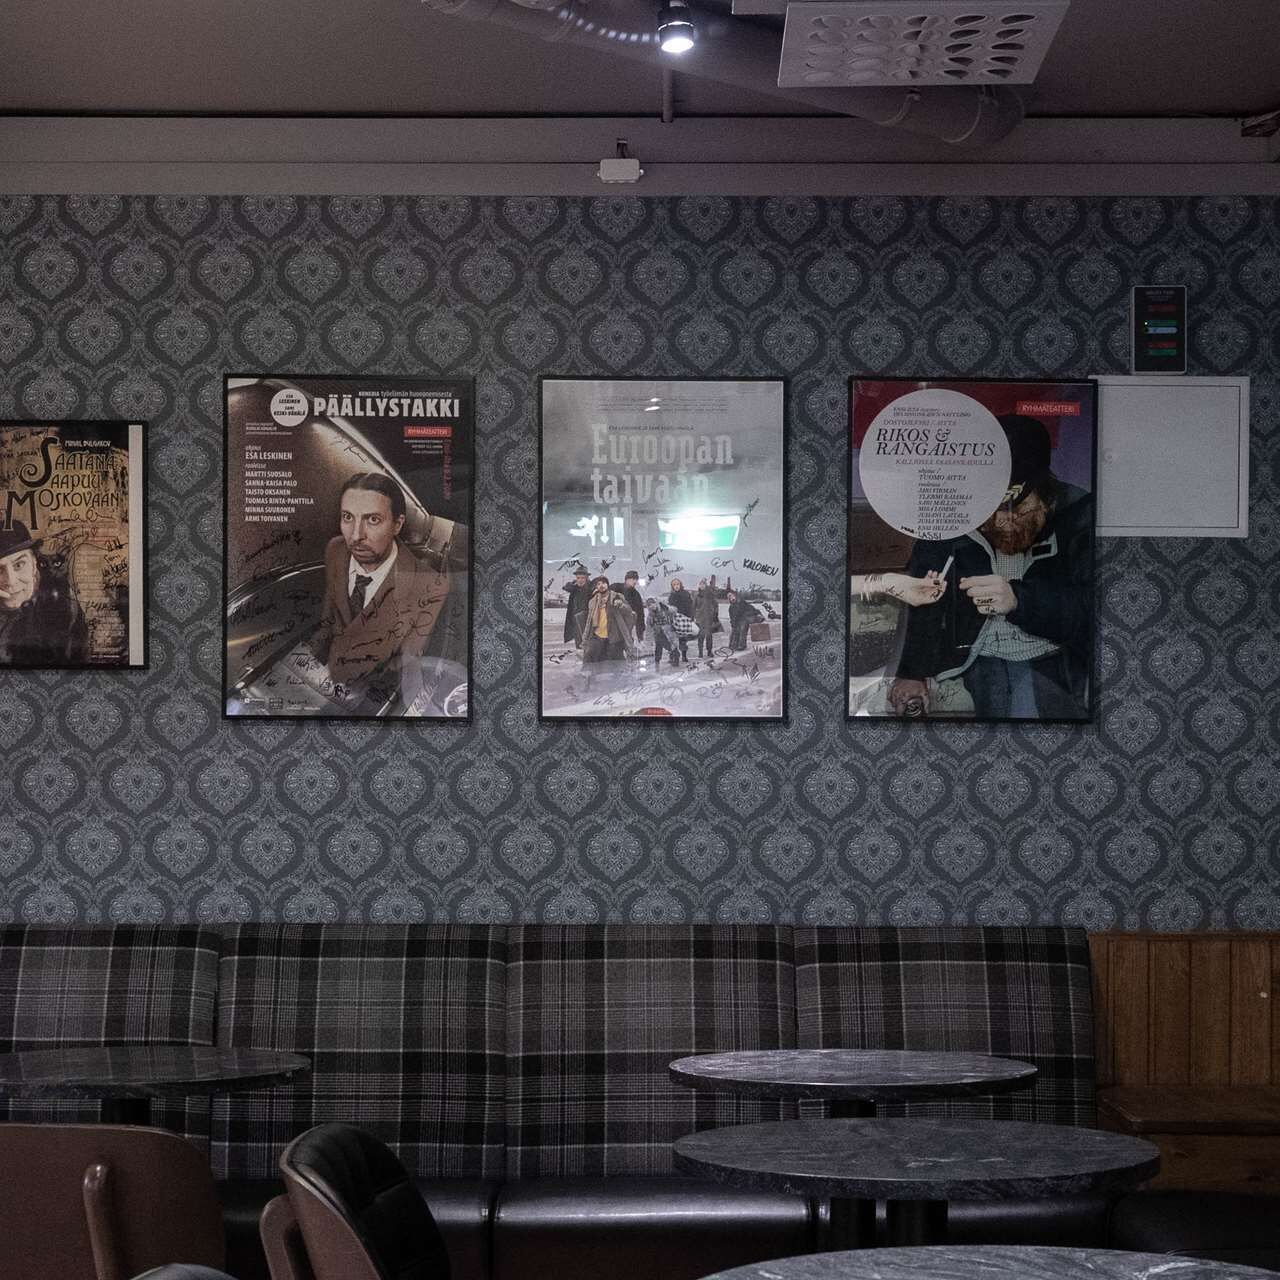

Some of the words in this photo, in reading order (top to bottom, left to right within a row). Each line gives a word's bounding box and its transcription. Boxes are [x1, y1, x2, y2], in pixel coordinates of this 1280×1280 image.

[313, 393, 460, 418] PÄÄLLYSTAKKI
[876, 428, 931, 441] RIKOS
[934, 428, 952, 442] &
[245, 452, 258, 460] ESA
[259, 452, 293, 460] LESKINEN
[591, 423, 734, 473] Euroopan
[876, 442, 996, 456] RANGAISTUS
[2, 488, 120, 532] MOSKOVAAN
